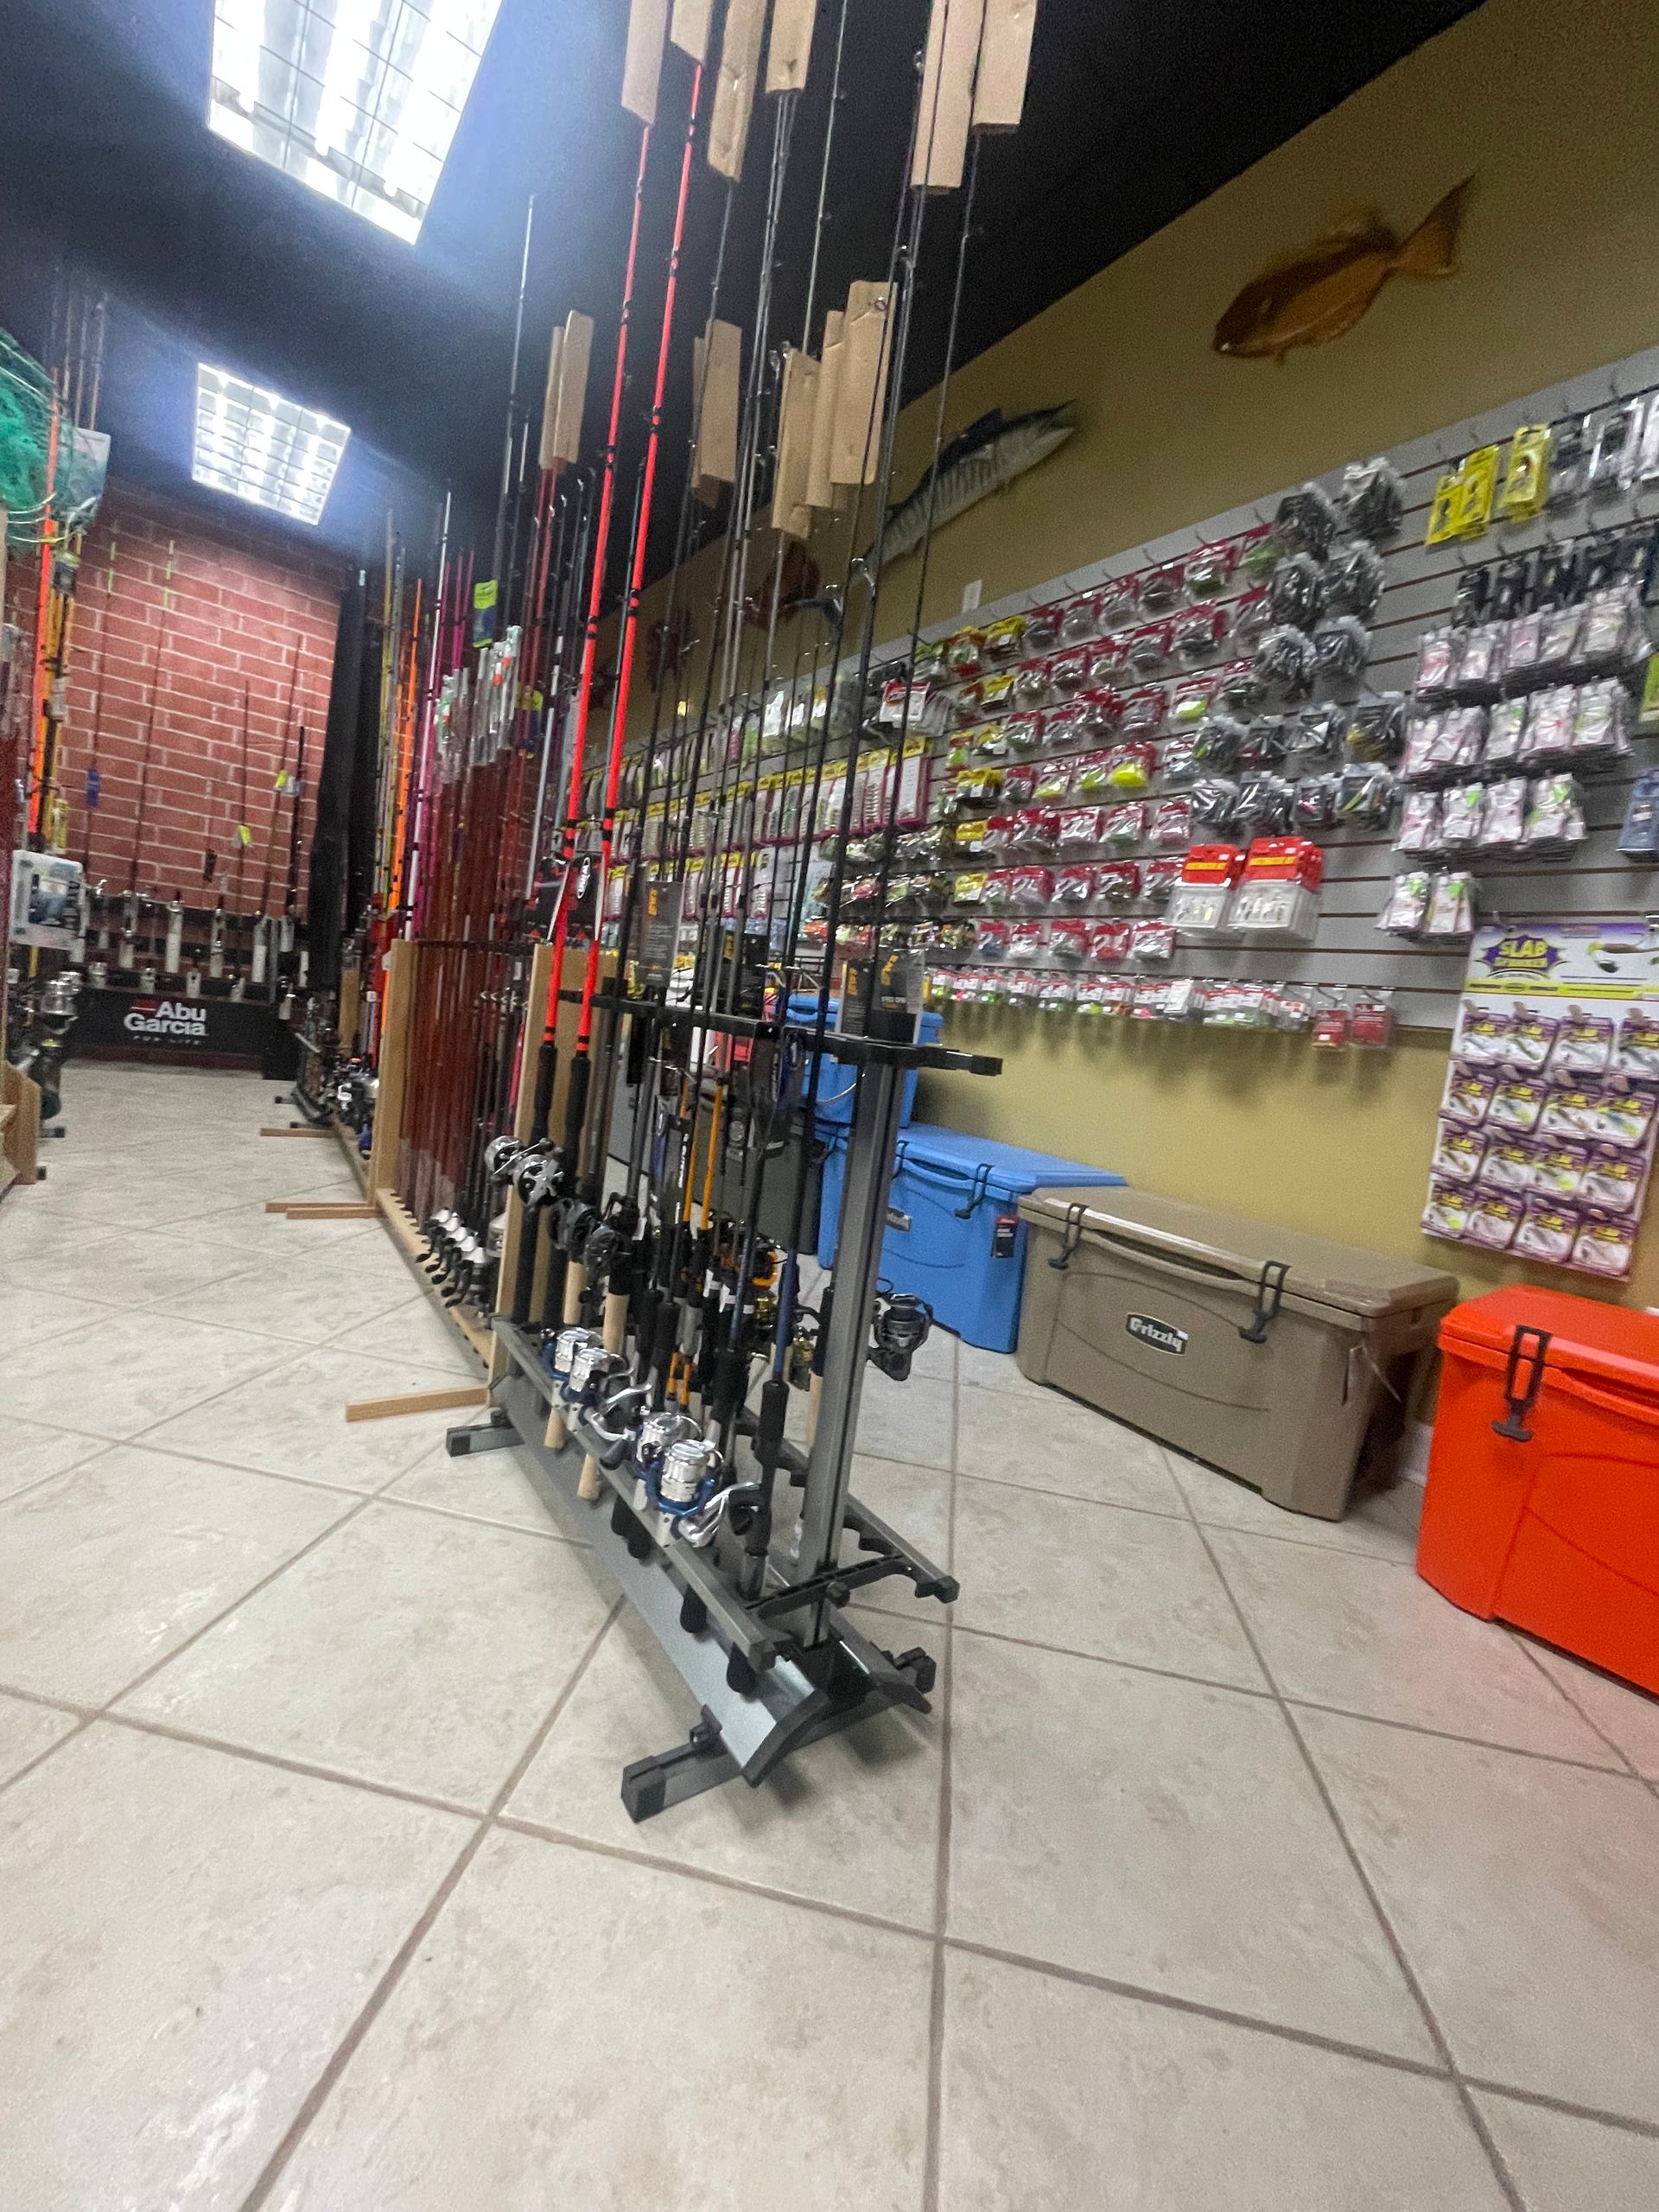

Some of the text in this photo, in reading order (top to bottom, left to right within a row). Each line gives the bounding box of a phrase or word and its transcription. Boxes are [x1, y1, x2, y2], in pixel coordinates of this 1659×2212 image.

[1498, 939, 1548, 958] SLAB
[155, 1001, 207, 1021] Abu
[124, 1013, 207, 1035] Garcia
[1129, 1317, 1183, 1351] Grizzly
